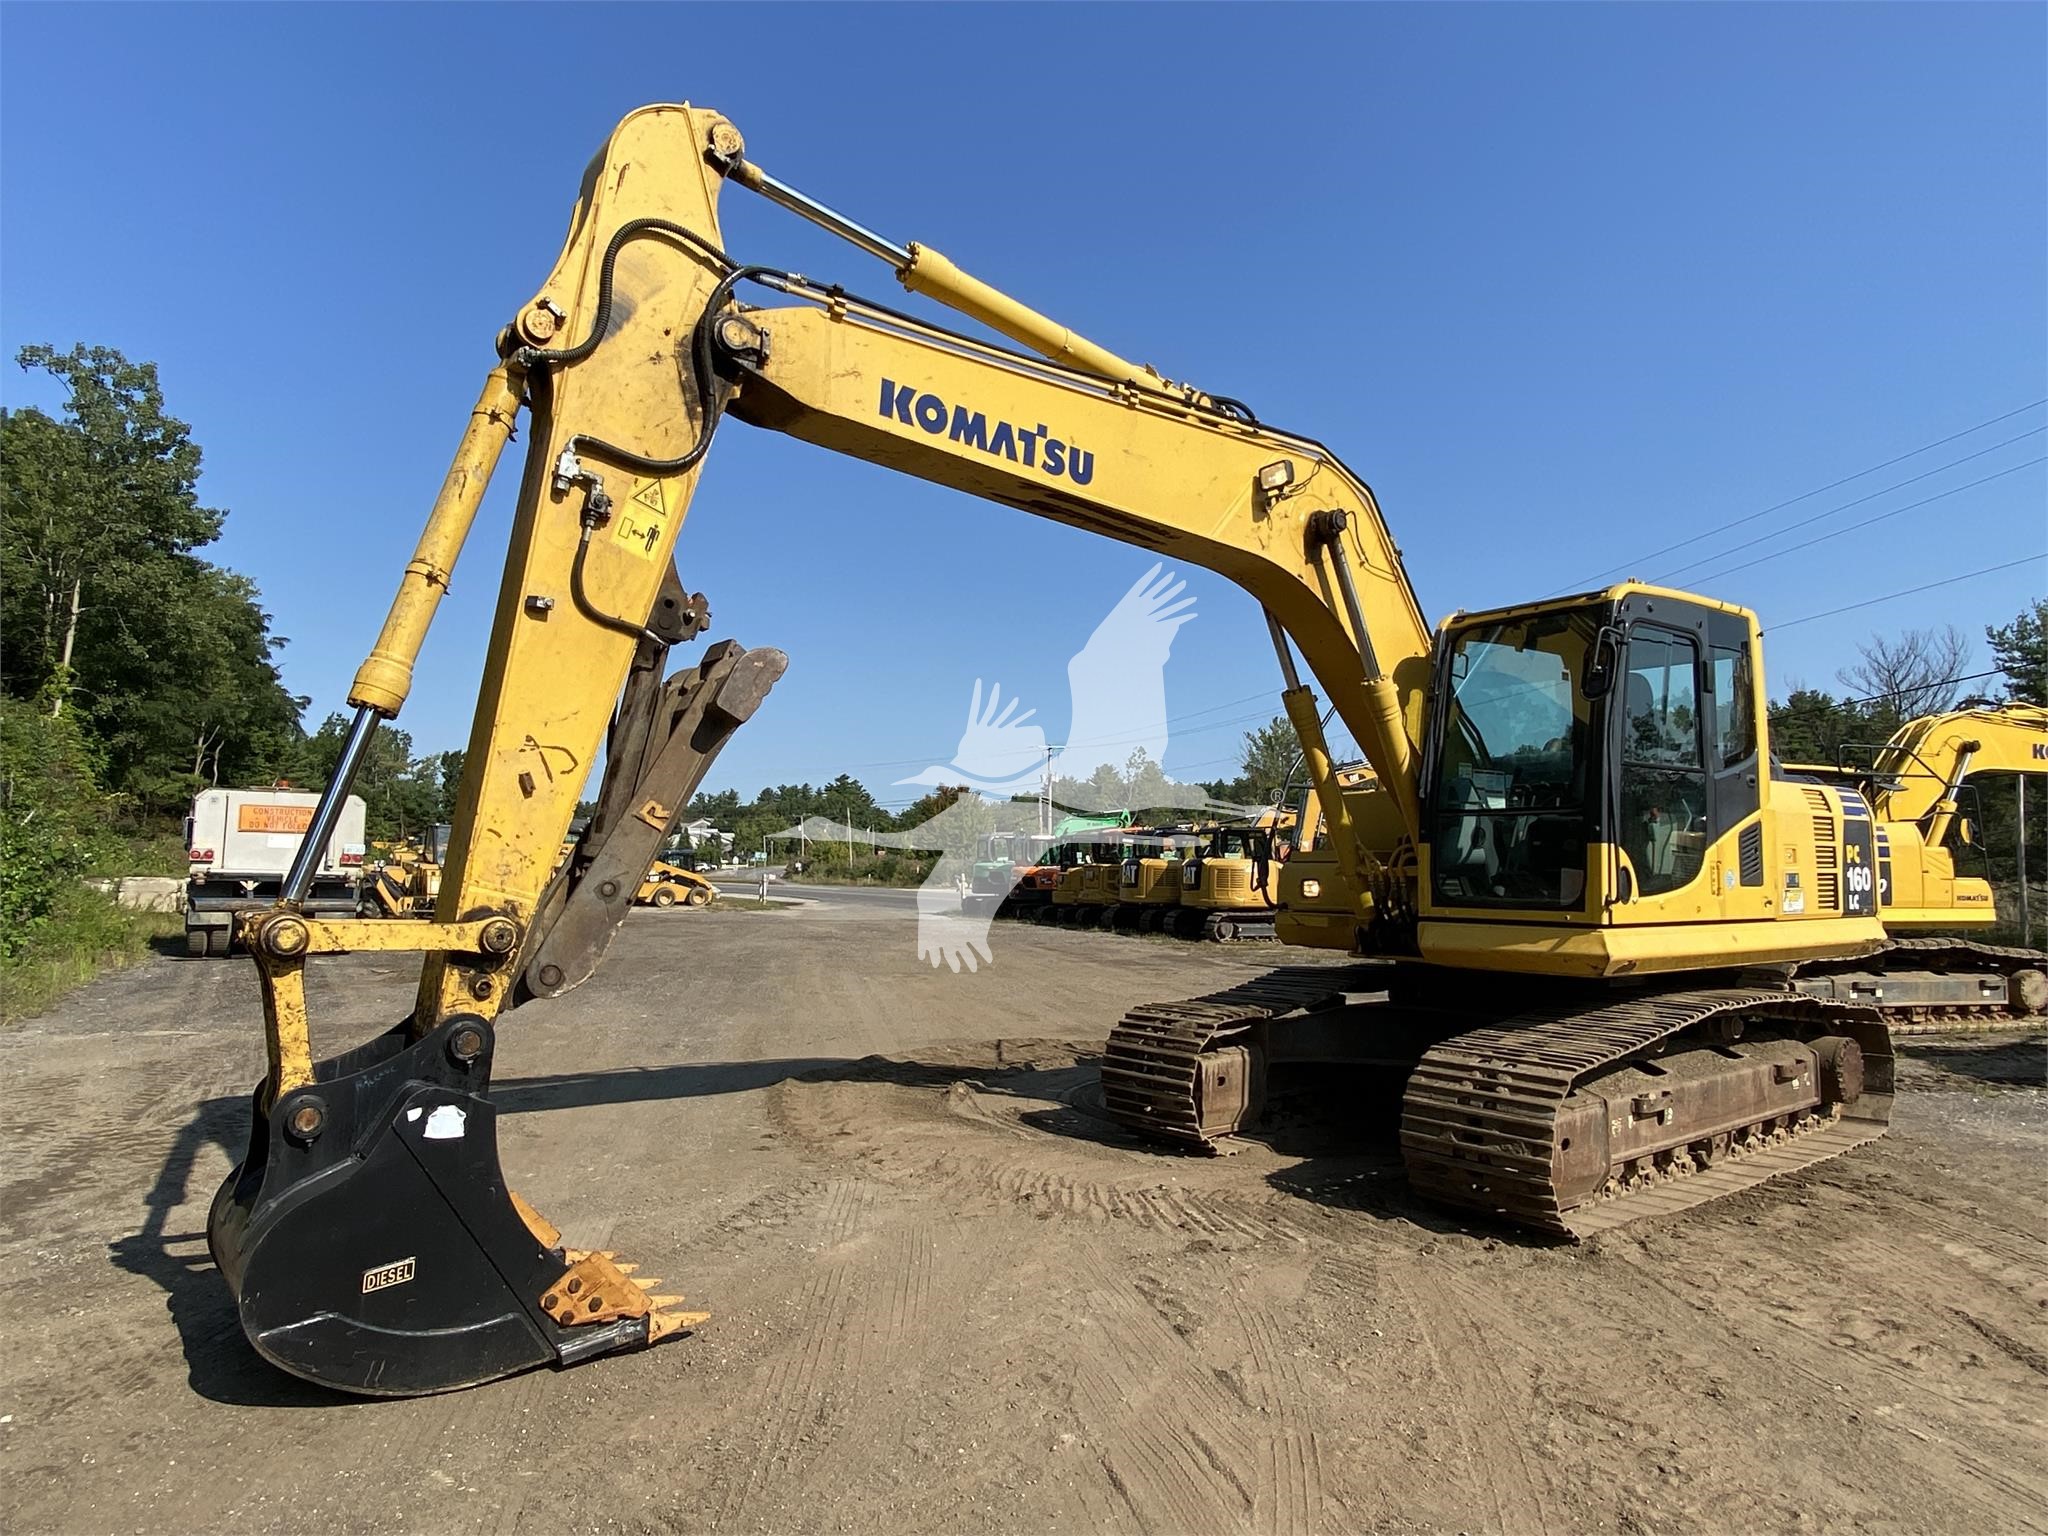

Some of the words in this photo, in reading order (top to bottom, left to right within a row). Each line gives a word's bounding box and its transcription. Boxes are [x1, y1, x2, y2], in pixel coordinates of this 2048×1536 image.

[879, 377, 1095, 486] KOMATSU
[253, 807, 313, 817] CONSTRUCTION
[249, 820, 260, 829] DO
[263, 821, 278, 830] NOT
[282, 822, 308, 830] FOLLO
[1845, 844, 1860, 864] PC
[1846, 866, 1871, 892] 160
[1848, 894, 1860, 910] LC
[366, 1265, 411, 1290] DIESEL
